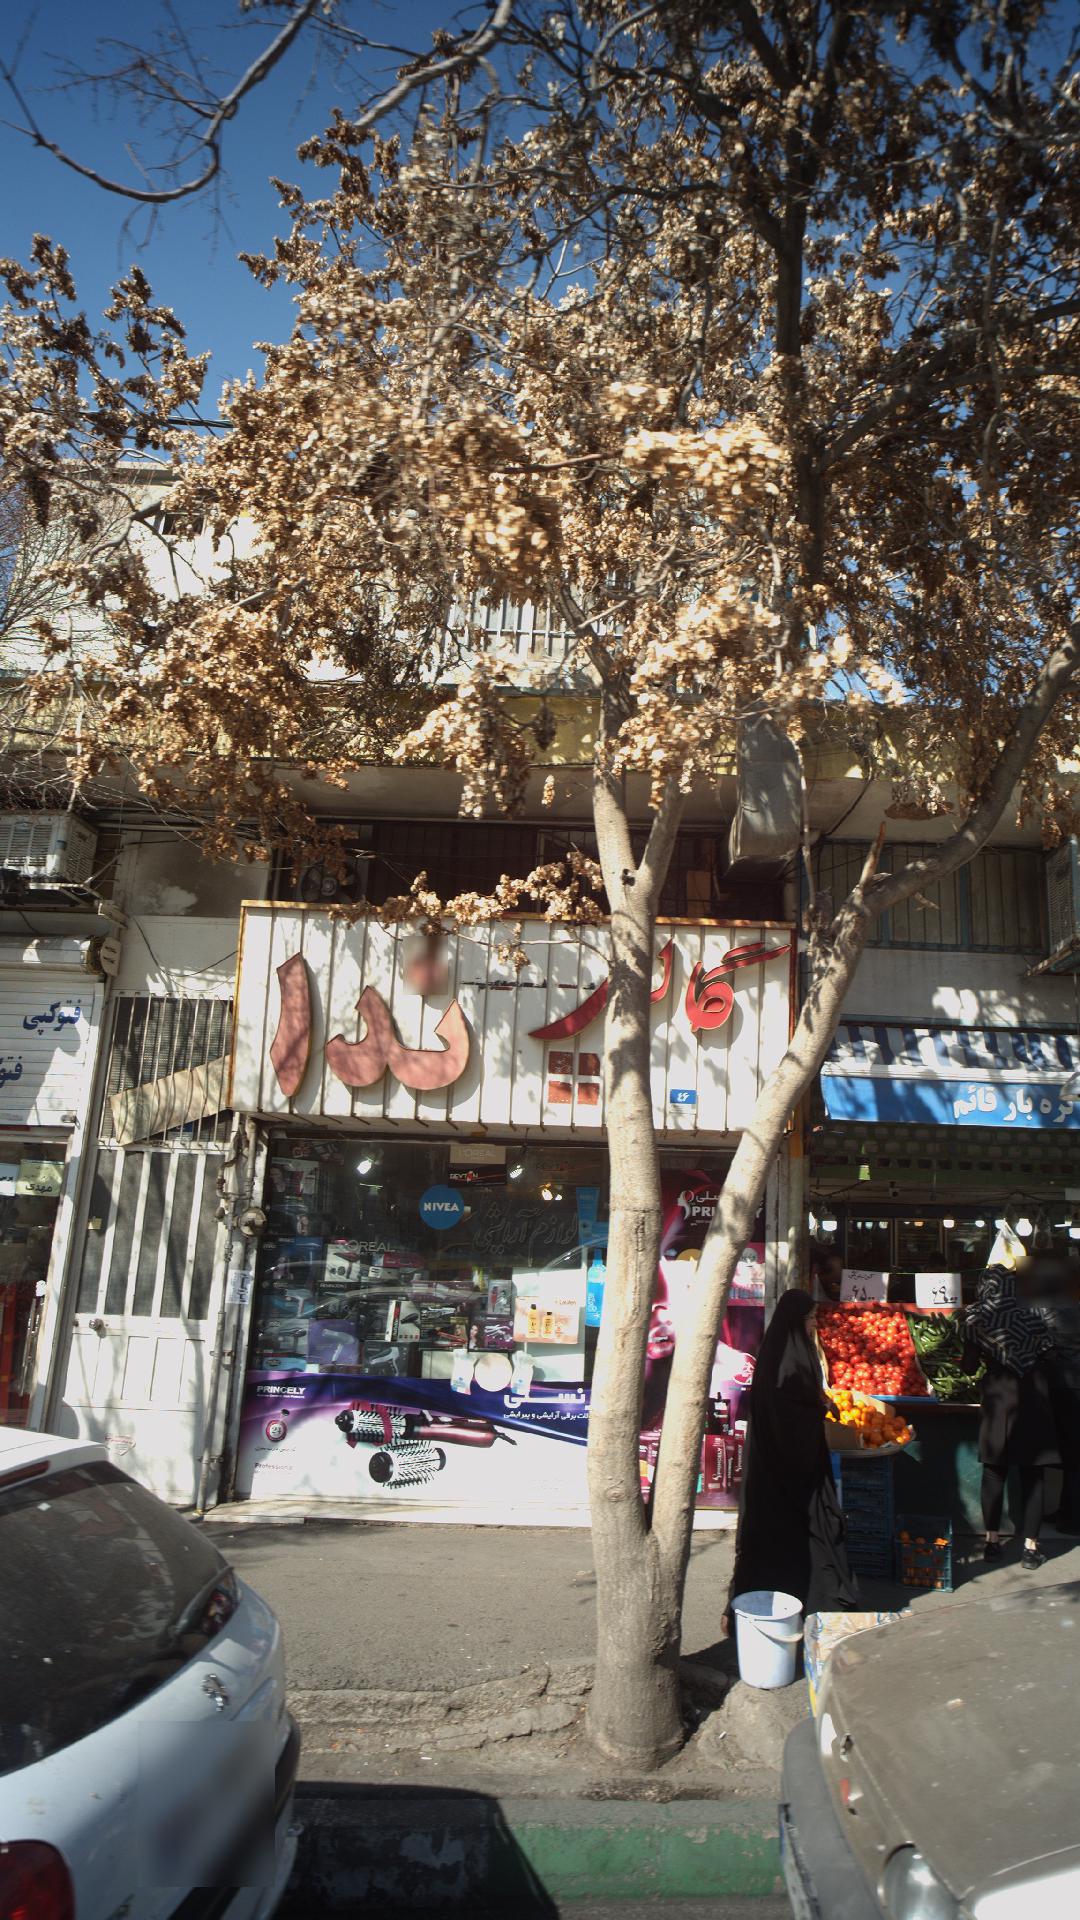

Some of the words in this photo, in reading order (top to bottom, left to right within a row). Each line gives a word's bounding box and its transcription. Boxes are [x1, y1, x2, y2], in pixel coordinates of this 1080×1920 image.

[23, 998, 81, 1035] فتوکپی
[953, 1085, 998, 1119] قائم
[1002, 1088, 1034, 1122] بار
[424, 1202, 460, 1213] NIVEA
[256, 1385, 306, 1395] PRINCELY
[503, 1410, 531, 1421] پیرایشی
[537, 1410, 560, 1420] آرایشی
[561, 1412, 576, 1421] برقی
